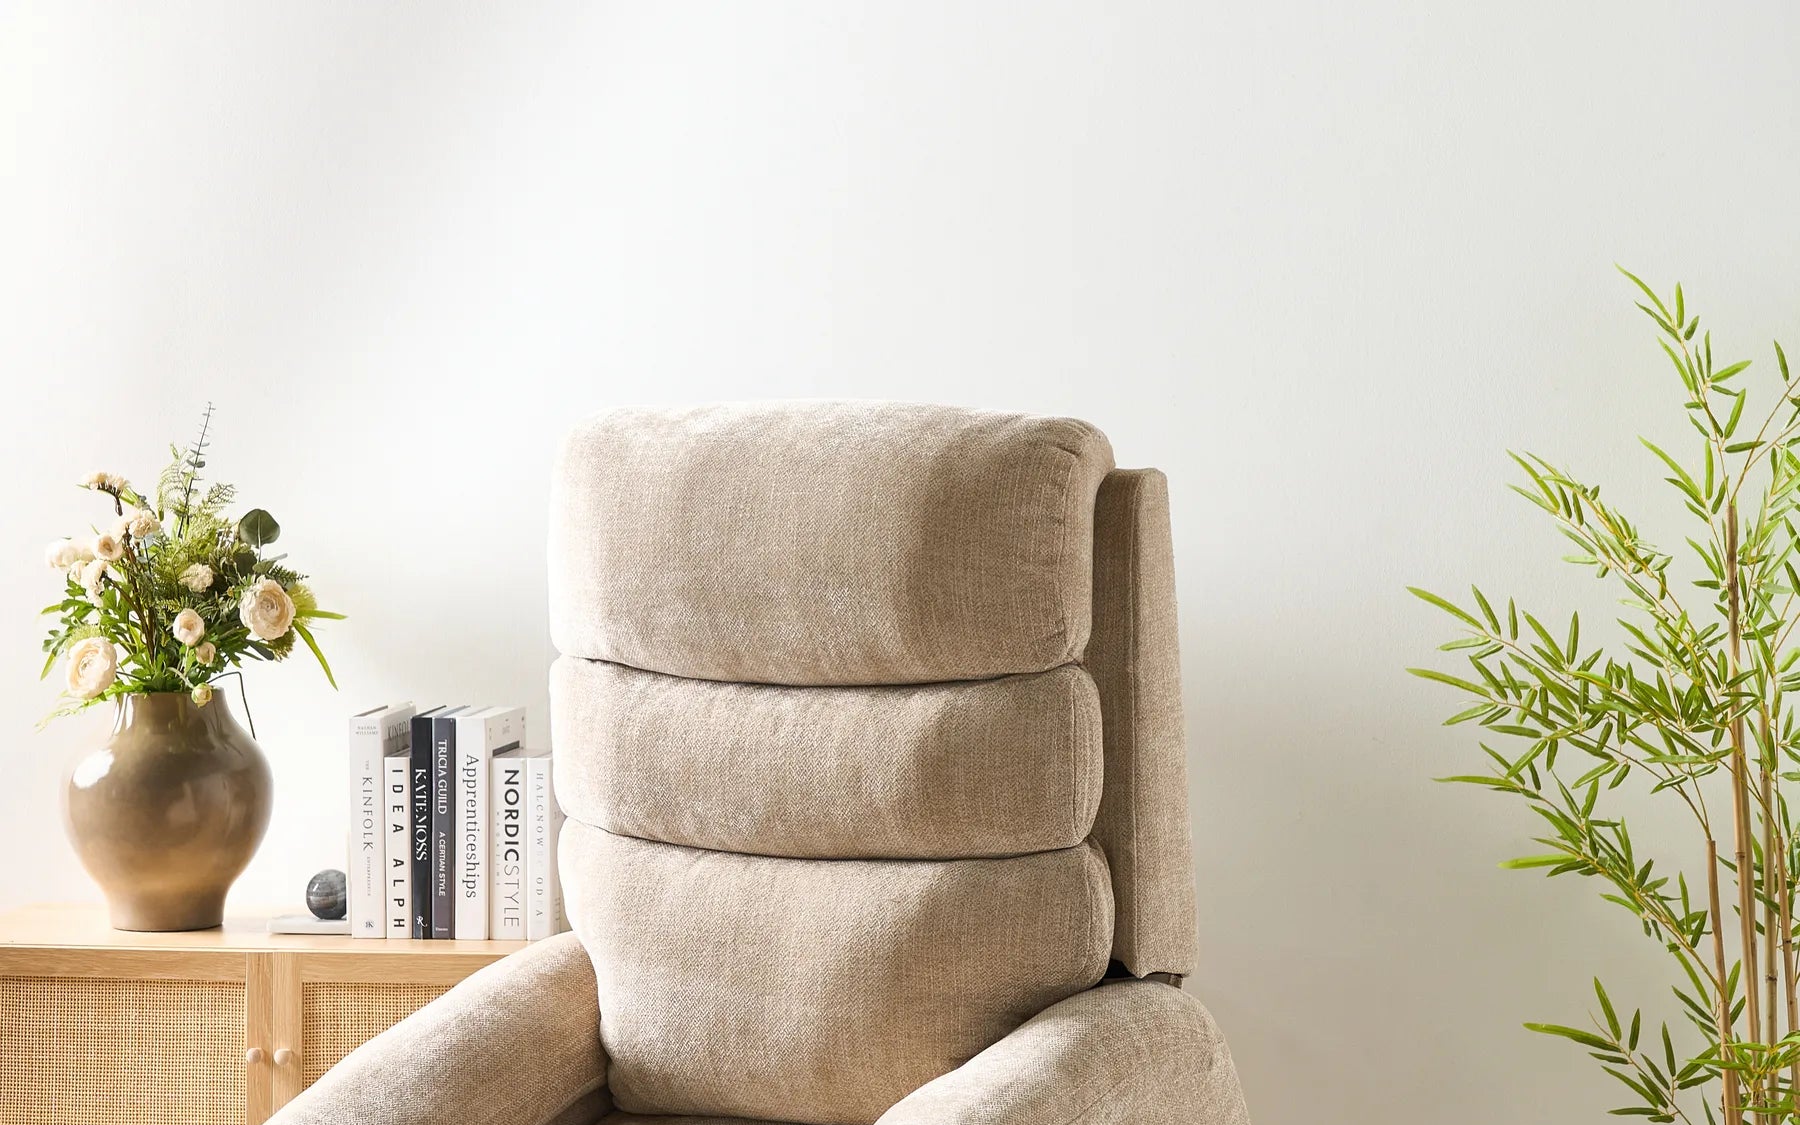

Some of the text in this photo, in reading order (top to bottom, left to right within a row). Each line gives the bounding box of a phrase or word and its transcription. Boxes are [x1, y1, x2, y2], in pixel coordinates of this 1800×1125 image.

[437, 739, 447, 777] TRICIA
[362, 776, 374, 851] KINFOLK
[415, 768, 427, 861] KATE MOSS
[437, 779, 447, 815] GUILD
[462, 754, 480, 899] Apprenticeships
[391, 769, 405, 928] IDEA ALPH
[438, 873, 446, 897] STYLE
